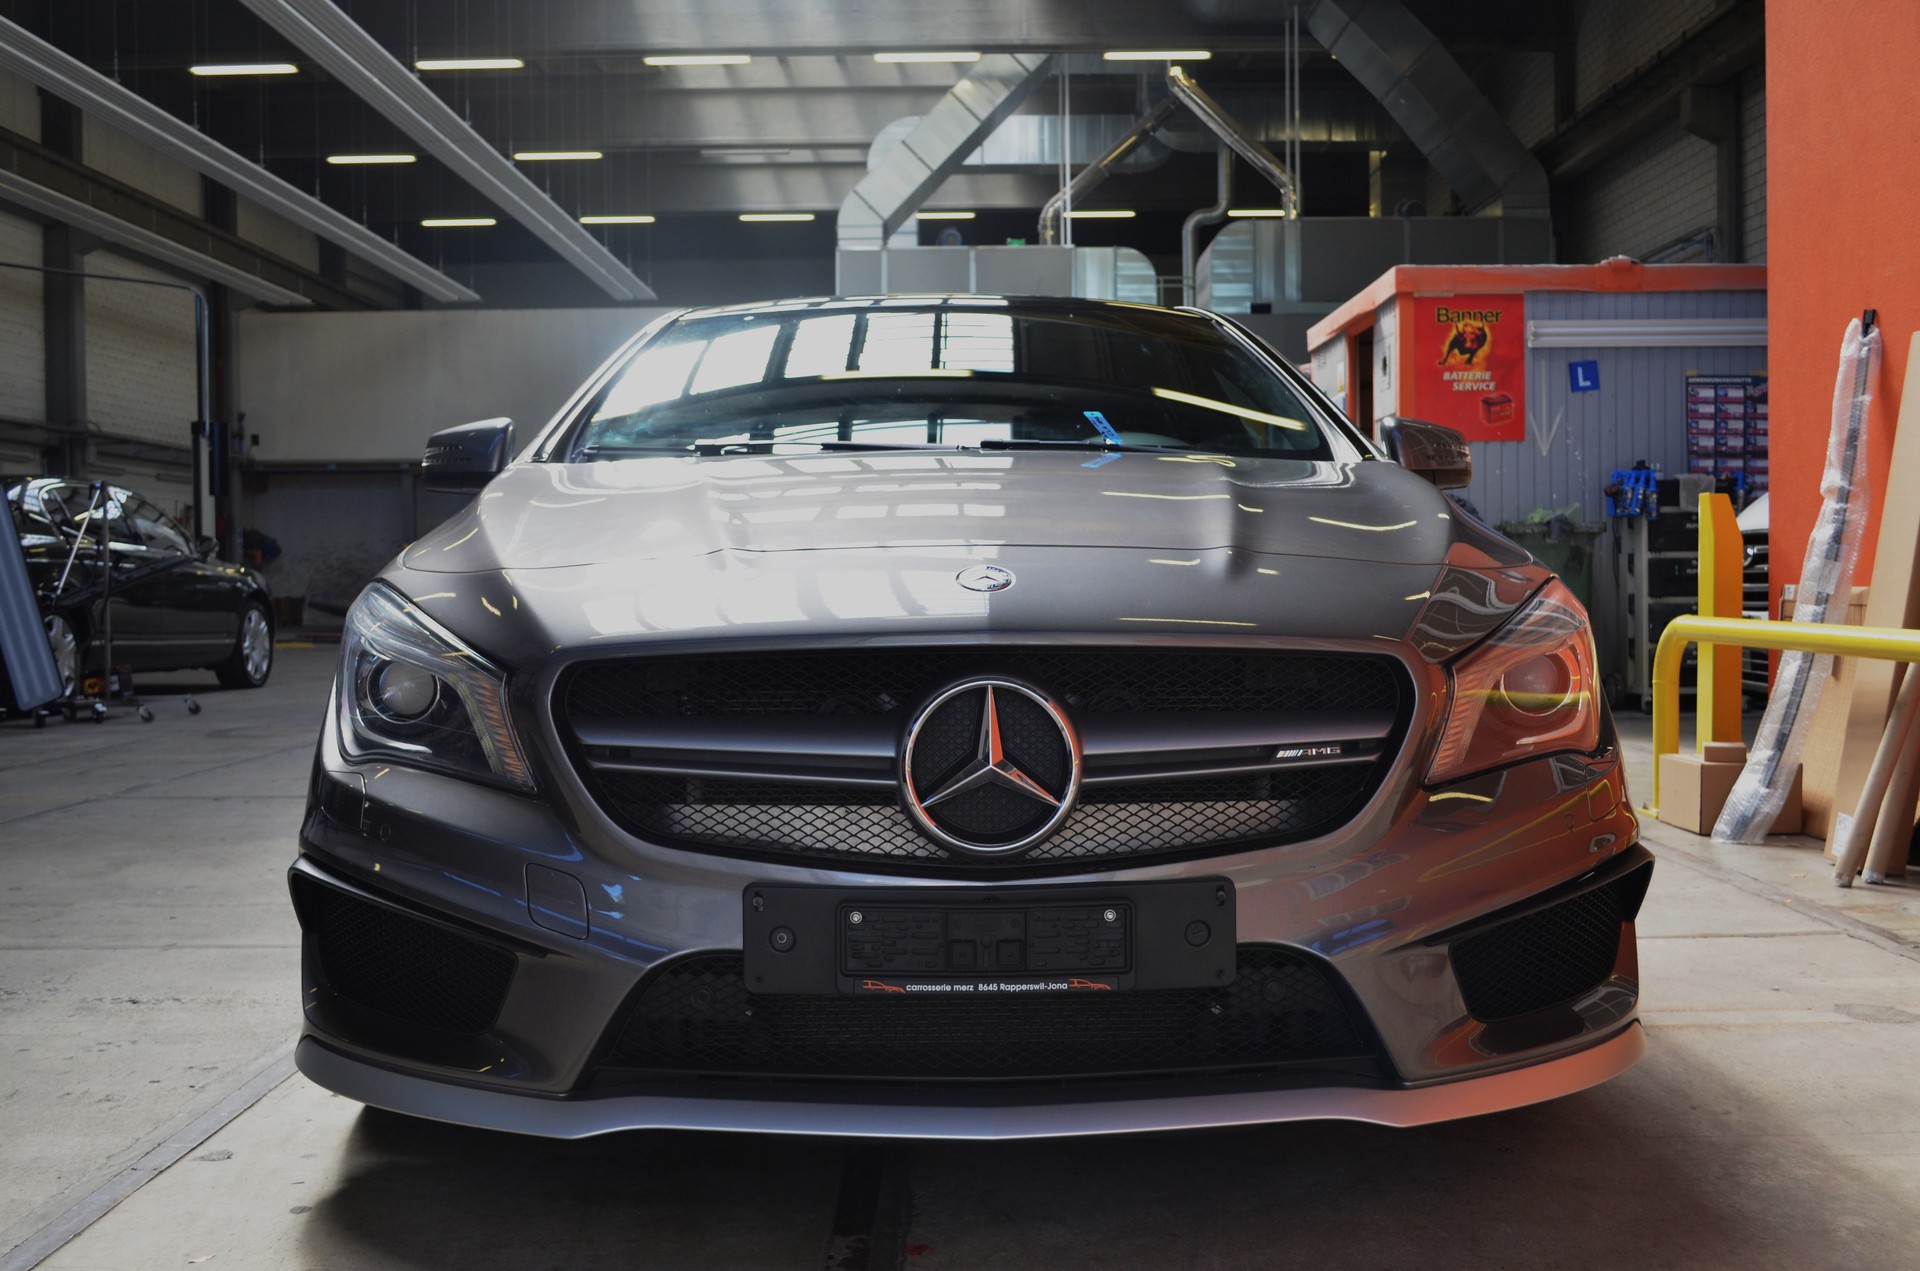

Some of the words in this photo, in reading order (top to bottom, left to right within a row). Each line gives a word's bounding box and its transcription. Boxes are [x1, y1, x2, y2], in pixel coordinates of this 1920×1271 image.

[1437, 307, 1502, 323] Banner
[1443, 371, 1492, 381] BATTERIE
[1577, 366, 1592, 387] L
[1452, 381, 1497, 391] SERVICE
[1297, 747, 1341, 757] AMG
[906, 983, 951, 992] carrosserie
[953, 984, 974, 992] merz
[978, 983, 998, 991] 8645
[1000, 982, 1068, 992] Rapperswil-Jona
